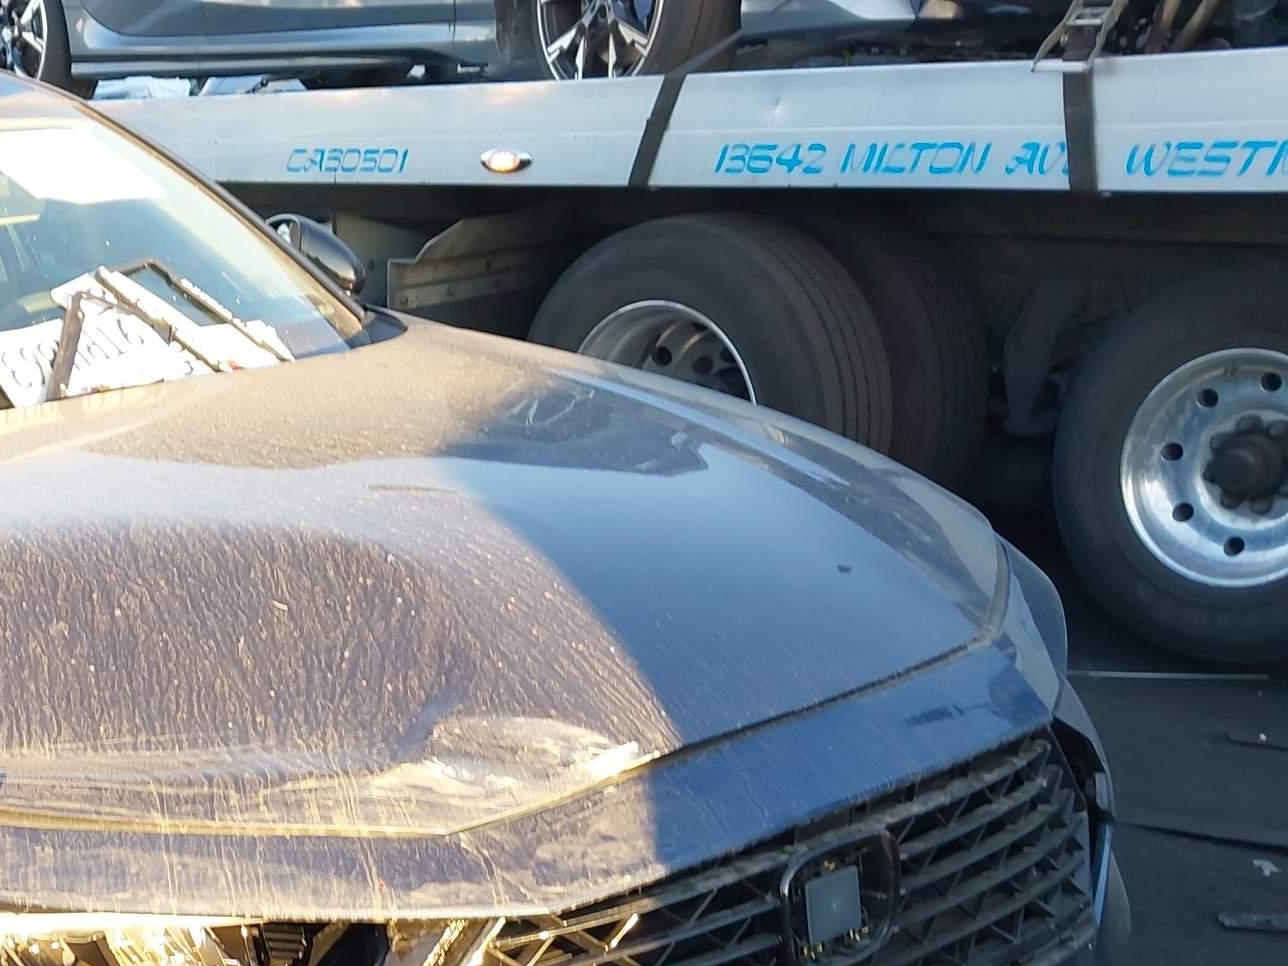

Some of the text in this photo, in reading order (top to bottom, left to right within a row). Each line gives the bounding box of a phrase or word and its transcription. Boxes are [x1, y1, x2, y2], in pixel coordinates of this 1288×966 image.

[286, 148, 409, 173] CA30501
[714, 143, 826, 174] 13642
[839, 142, 993, 174] MILTON
[1005, 142, 1069, 175] AV
